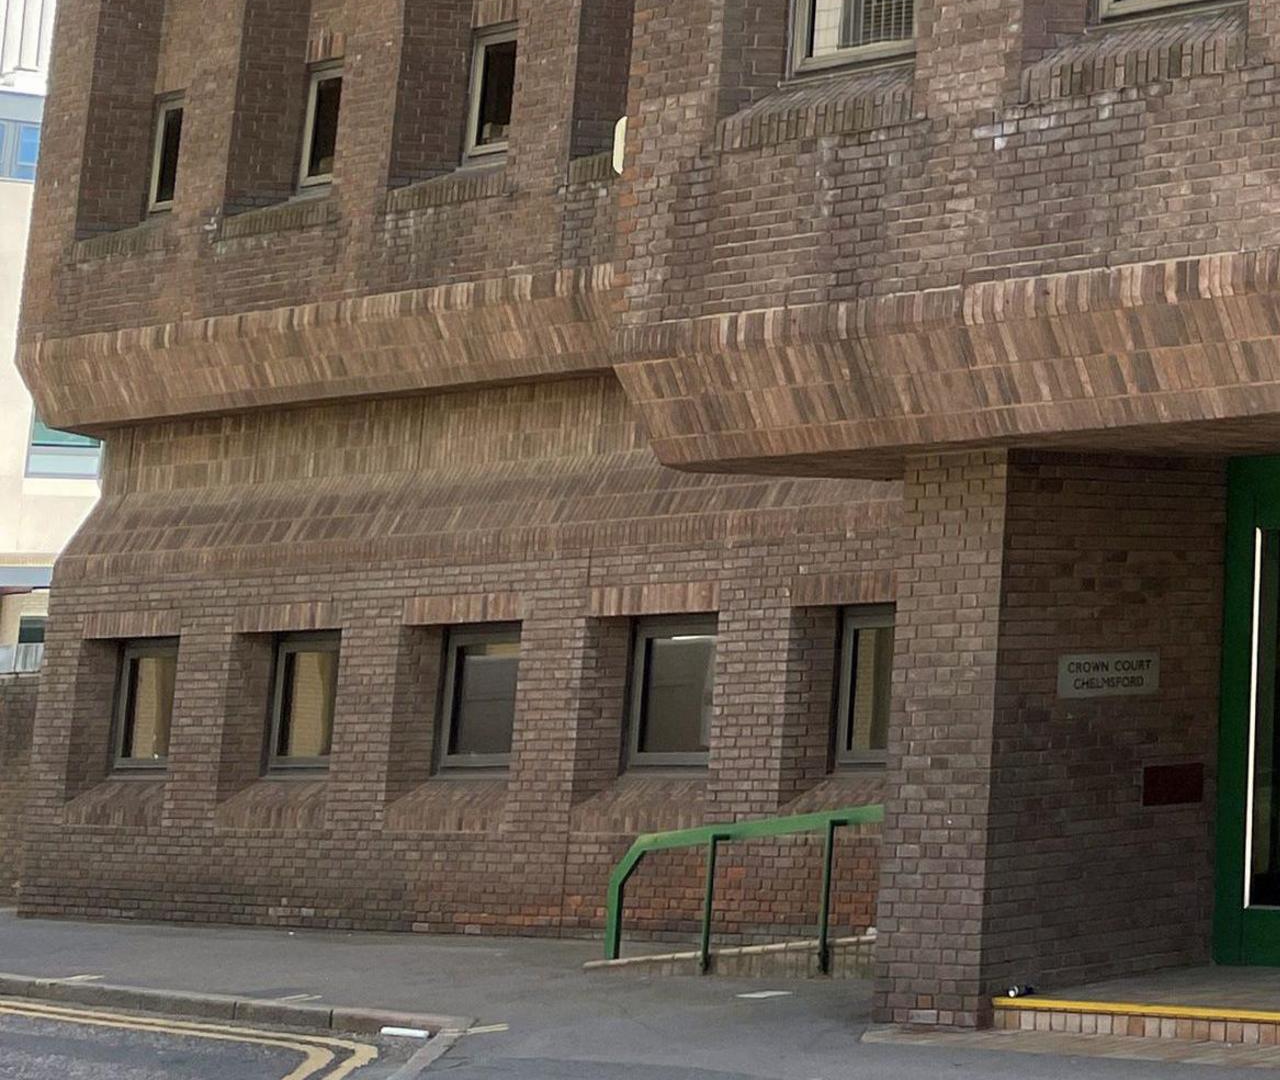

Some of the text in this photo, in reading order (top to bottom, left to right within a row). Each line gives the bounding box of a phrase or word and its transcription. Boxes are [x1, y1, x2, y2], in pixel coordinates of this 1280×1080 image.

[1067, 659, 1152, 674] CROWN COURT
[1073, 675, 1145, 690] CHELMSFORD
